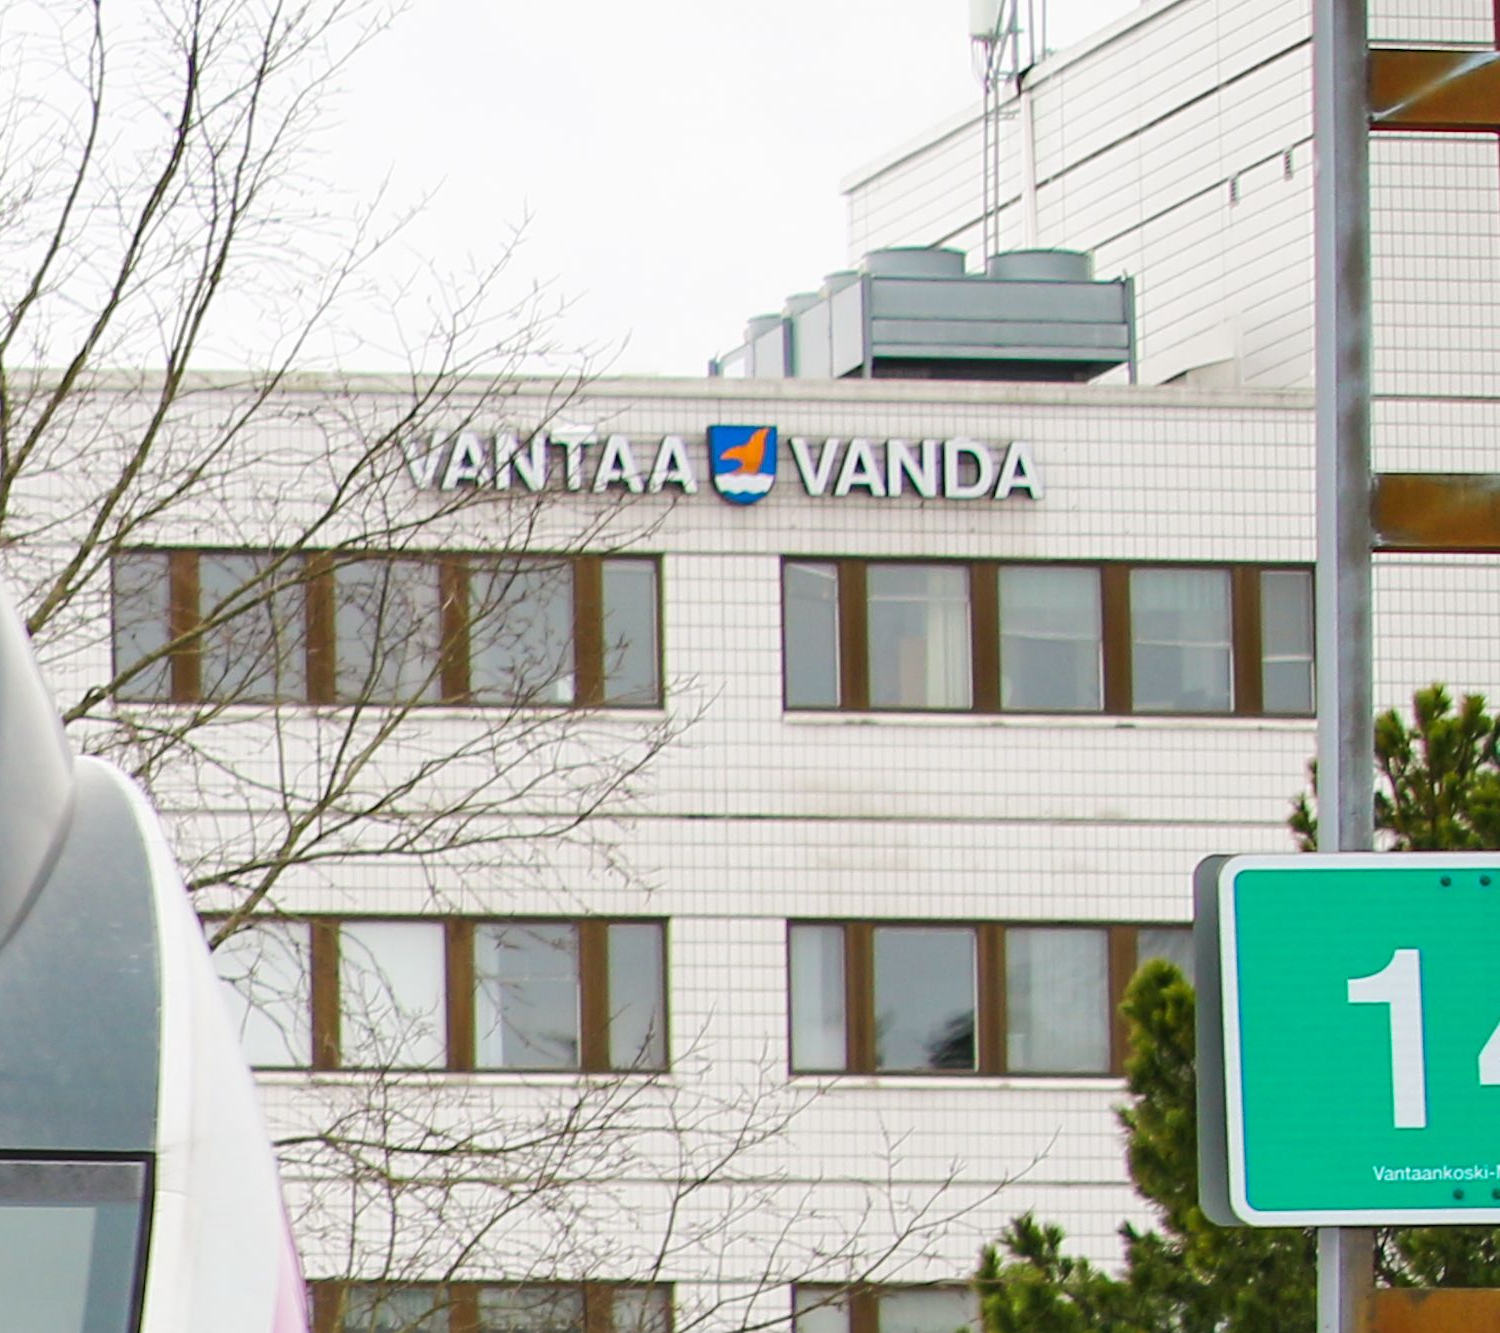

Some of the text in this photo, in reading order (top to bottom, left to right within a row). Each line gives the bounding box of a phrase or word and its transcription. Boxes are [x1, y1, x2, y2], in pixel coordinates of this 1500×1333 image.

[401, 428, 698, 495] VANTAA
[789, 436, 1046, 499] VANDA
[1347, 948, 1500, 1129] 1
